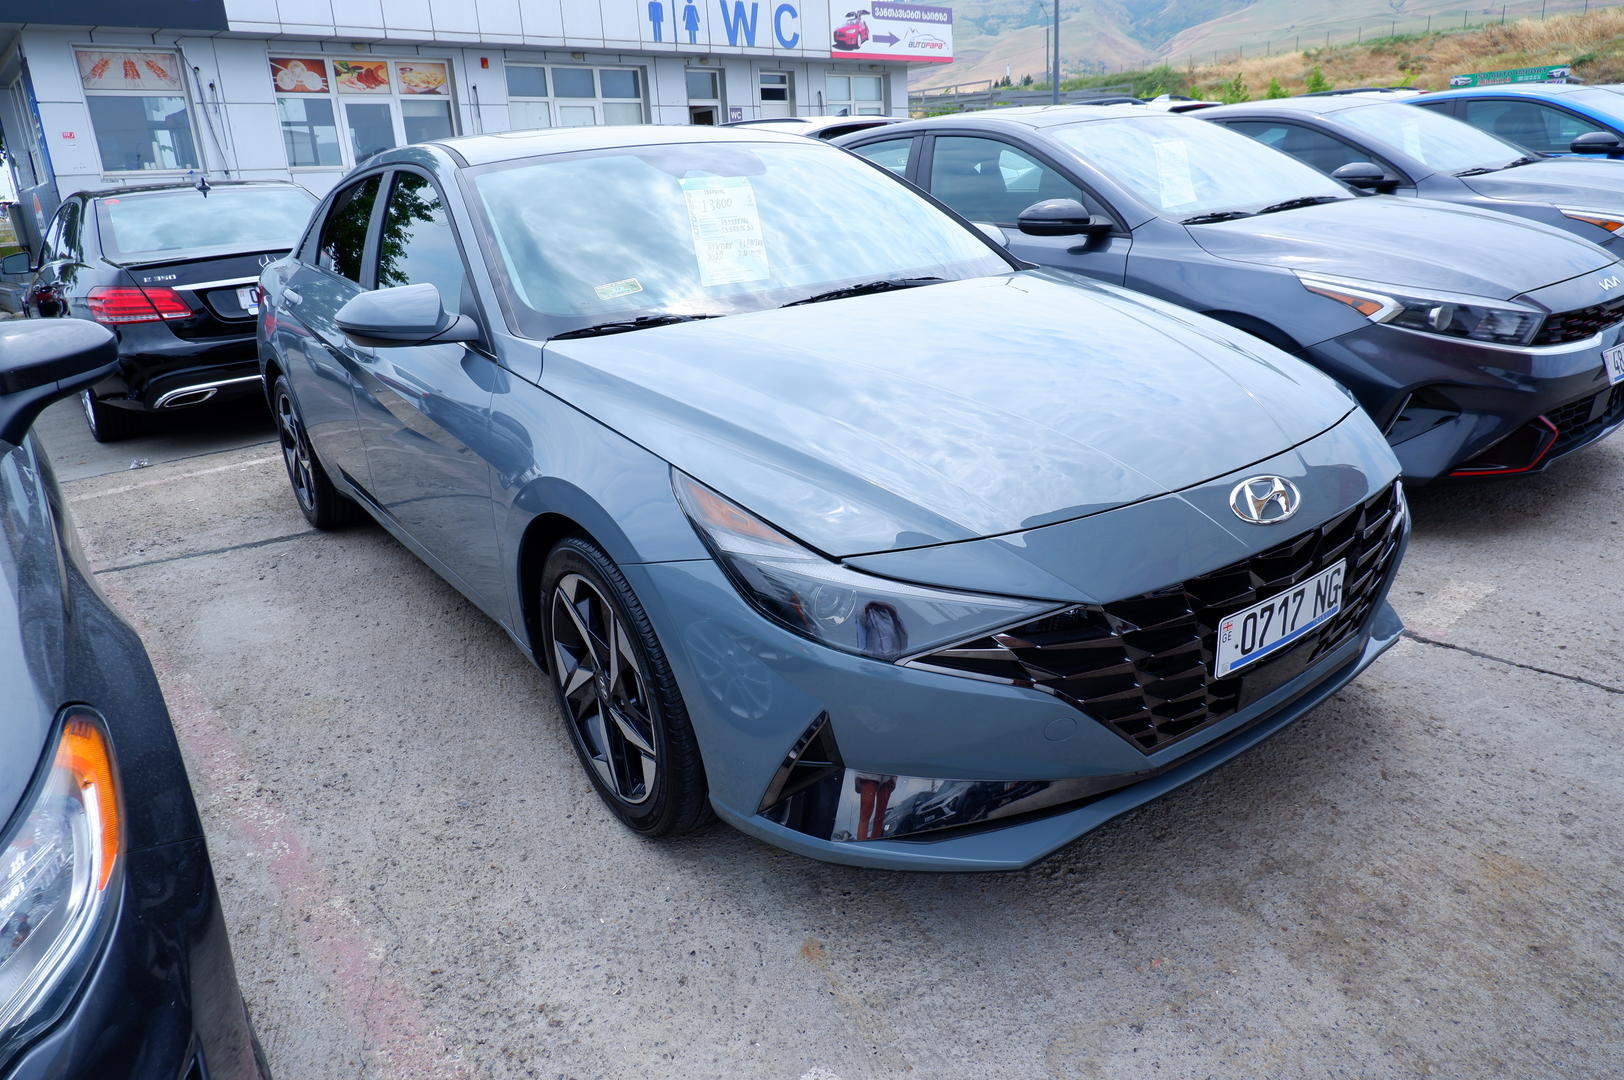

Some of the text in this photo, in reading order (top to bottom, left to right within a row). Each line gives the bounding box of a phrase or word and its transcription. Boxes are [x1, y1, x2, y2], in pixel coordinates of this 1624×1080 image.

[730, 111, 742, 120] WC
[1240, 567, 1341, 656] 0717 NG
[1221, 630, 1232, 644] GE
